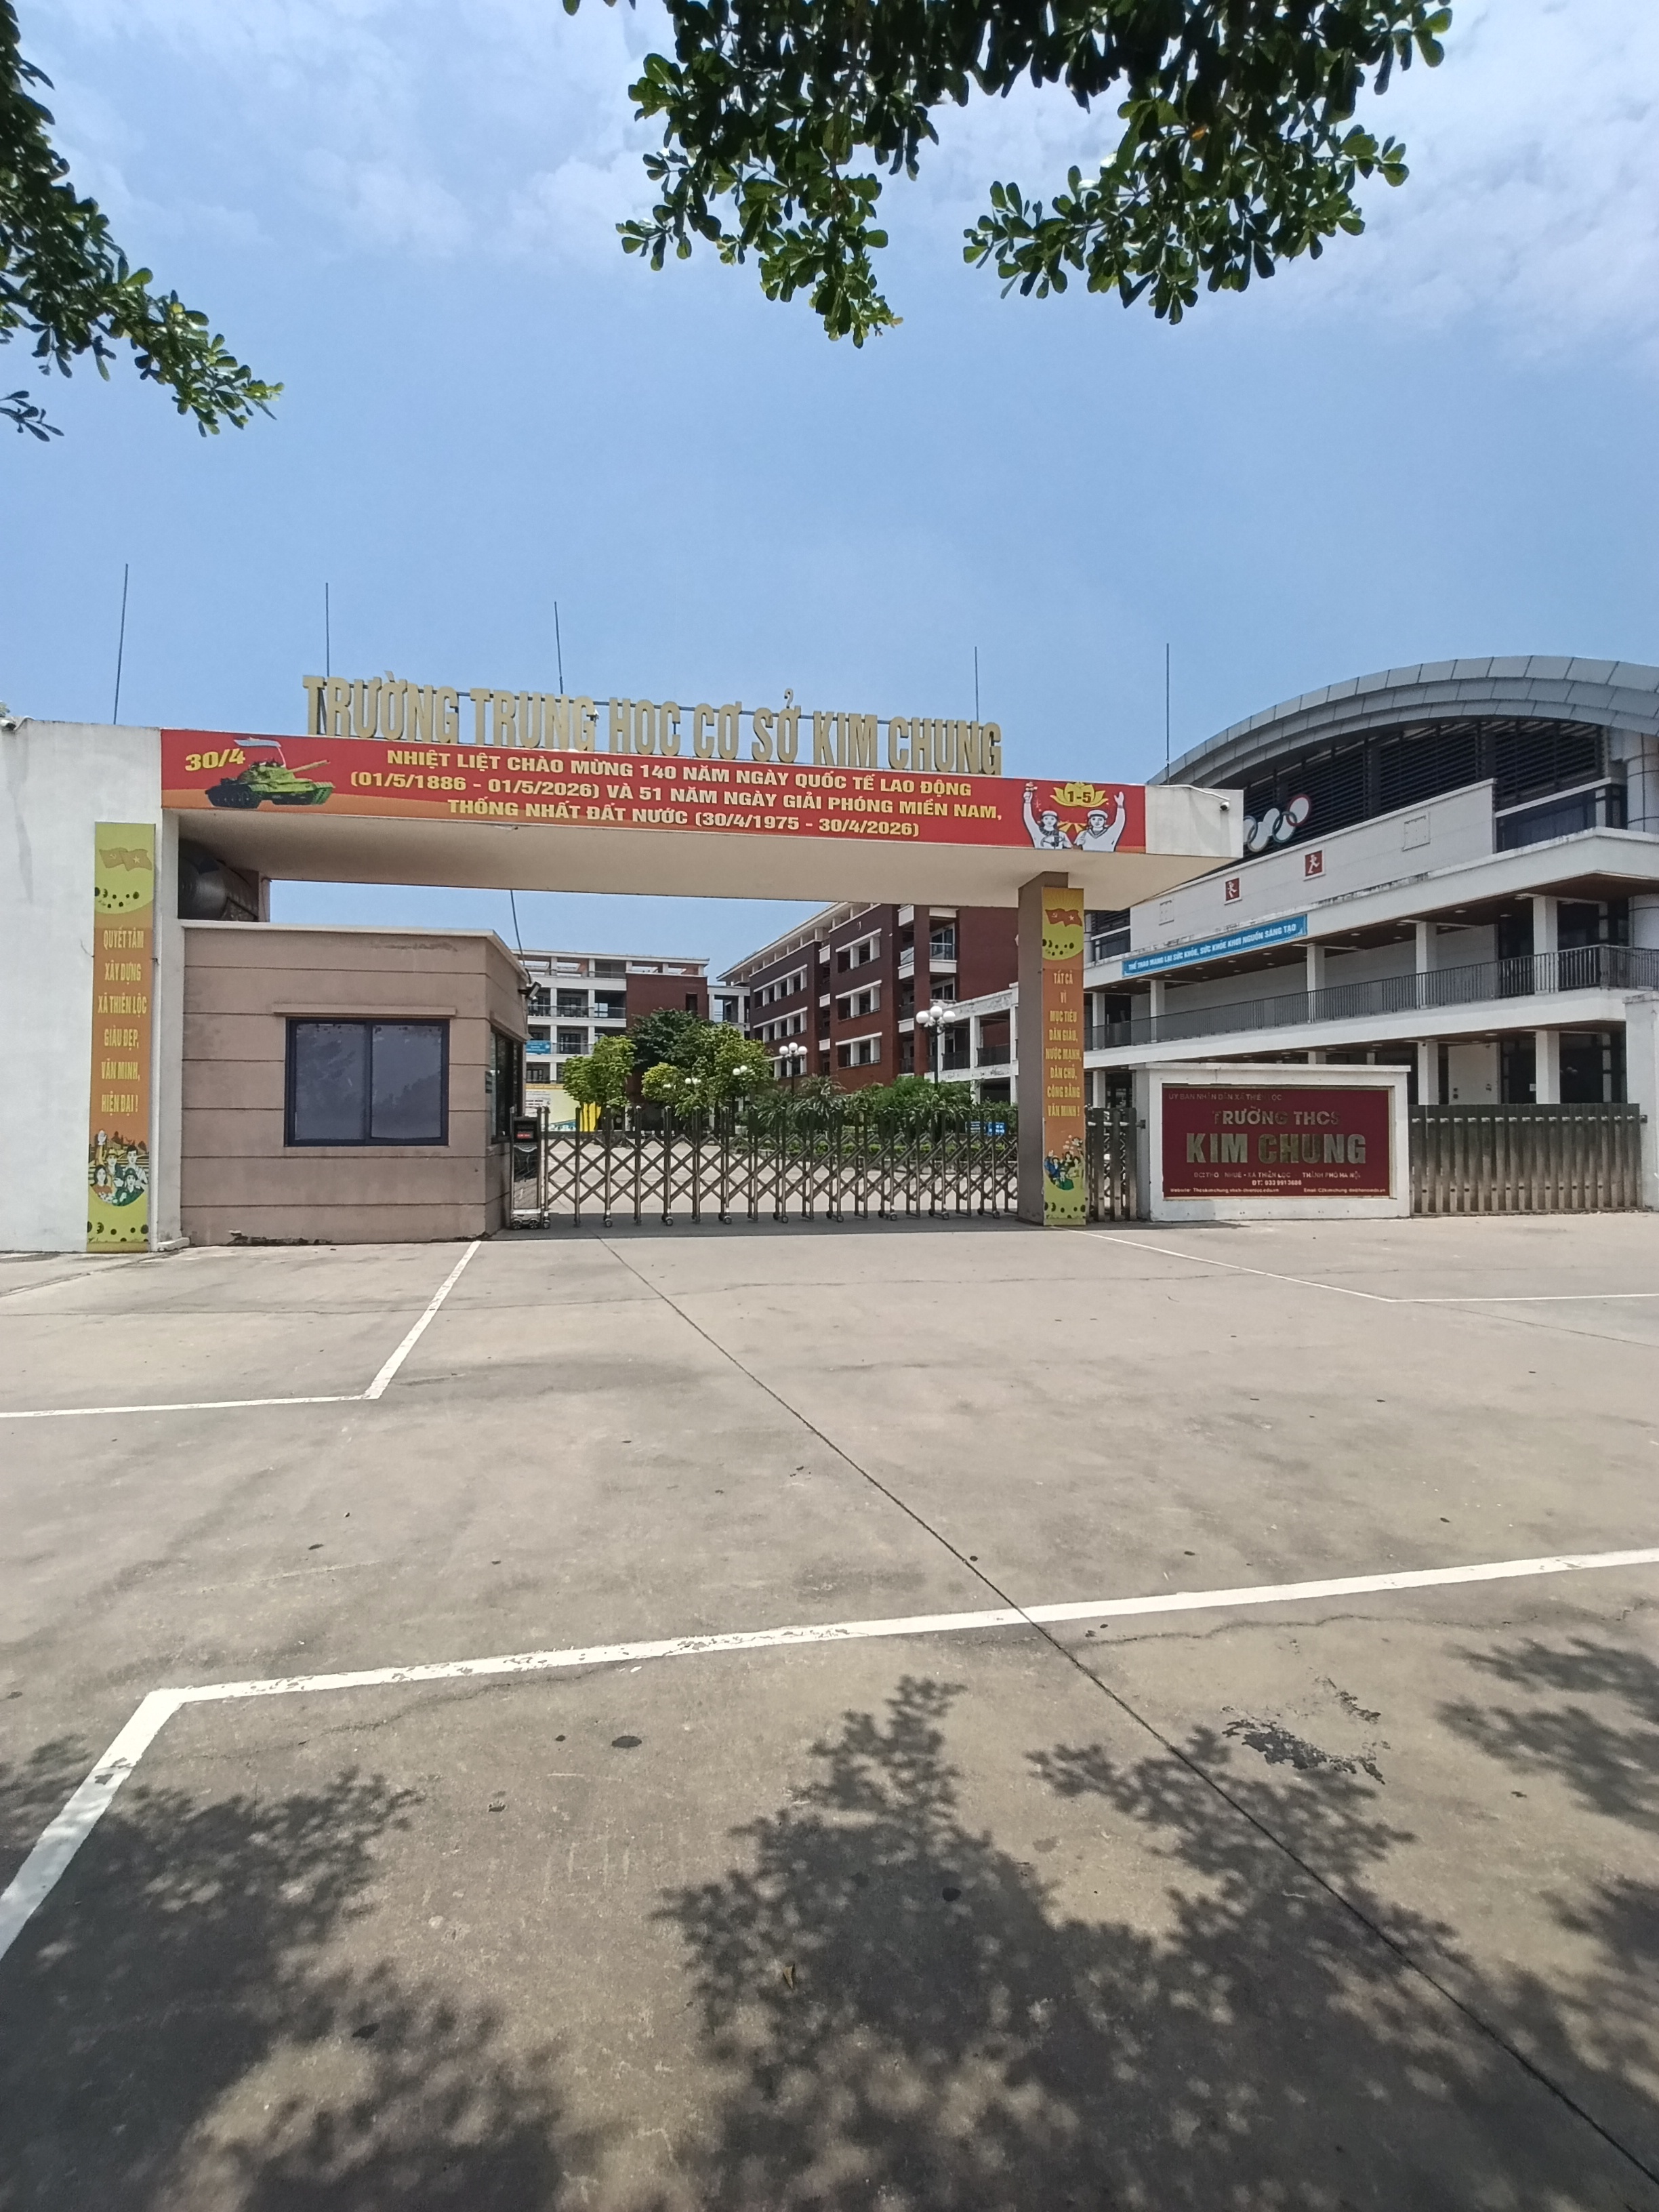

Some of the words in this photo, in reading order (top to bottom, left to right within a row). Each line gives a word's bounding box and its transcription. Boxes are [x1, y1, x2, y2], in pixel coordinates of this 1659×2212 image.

[302, 670, 459, 744] TRƯỜNG
[470, 688, 596, 752] TRUNG
[693, 701, 742, 760] CƠ
[751, 689, 802, 764] SỞ
[813, 711, 878, 769] KIM
[888, 716, 1002, 775] CHUNG
[185, 748, 246, 771] 30/4
[388, 750, 451, 767] NHIỆT
[457, 752, 501, 771] LIỆT
[507, 756, 564, 773] CHÀO
[571, 760, 634, 777] MỪNG
[640, 765, 676, 779] 140
[683, 764, 730, 782] NĂM
[737, 768, 789, 786] NGÀY
[795, 771, 848, 790] QUỐC
[853, 773, 874, 791] TẾ
[880, 778, 915, 793] LAO
[920, 777, 972, 798] ĐỘNG
[351, 771, 466, 790] (01/5/1886
[489, 779, 600, 798] 01/5/2026)
[607, 781, 634, 800] VÀ
[639, 786, 662, 801] 51
[670, 786, 718, 804] NĂM
[724, 790, 777, 808] NGÀY
[783, 791, 821, 810] GIẢI
[828, 795, 893, 813] PHÓNG
[899, 796, 948, 816] MIỀN
[954, 804, 1002, 821] NAM,
[1067, 790, 1092, 803] 1-5
[448, 796, 518, 816] THỐNG
[526, 800, 581, 819] NHẤT
[586, 802, 625, 821] ĐẤT
[632, 804, 688, 825] NƯỚC
[695, 811, 800, 830] (30/4/1975
[819, 817, 920, 837] 30/4/2026)
[103, 925, 127, 950] QUYẾT
[127, 927, 144, 948] TÂM
[1265, 928, 1283, 938] SÁNG
[1284, 924, 1296, 935] TẠO
[104, 960, 120, 981] XÂY
[121, 962, 142, 985] DỰNG
[1054, 969, 1064, 984] TẤT
[1065, 970, 1073, 984] CẢ
[98, 992, 108, 1014] XÃ
[109, 992, 132, 1014] THIÊN
[132, 992, 147, 1017] LỘC
[1060, 990, 1067, 1003] VÌ
[104, 1025, 123, 1046] GIÀU
[101, 1058, 117, 1080] VĂN
[101, 1091, 119, 1116] HIỆN
[120, 1094, 134, 1117] ĐẠI
[1293, 1110, 1341, 1126] THCS
[1186, 1132, 1248, 1164] KIM
[1258, 1133, 1366, 1164] CHUNG
